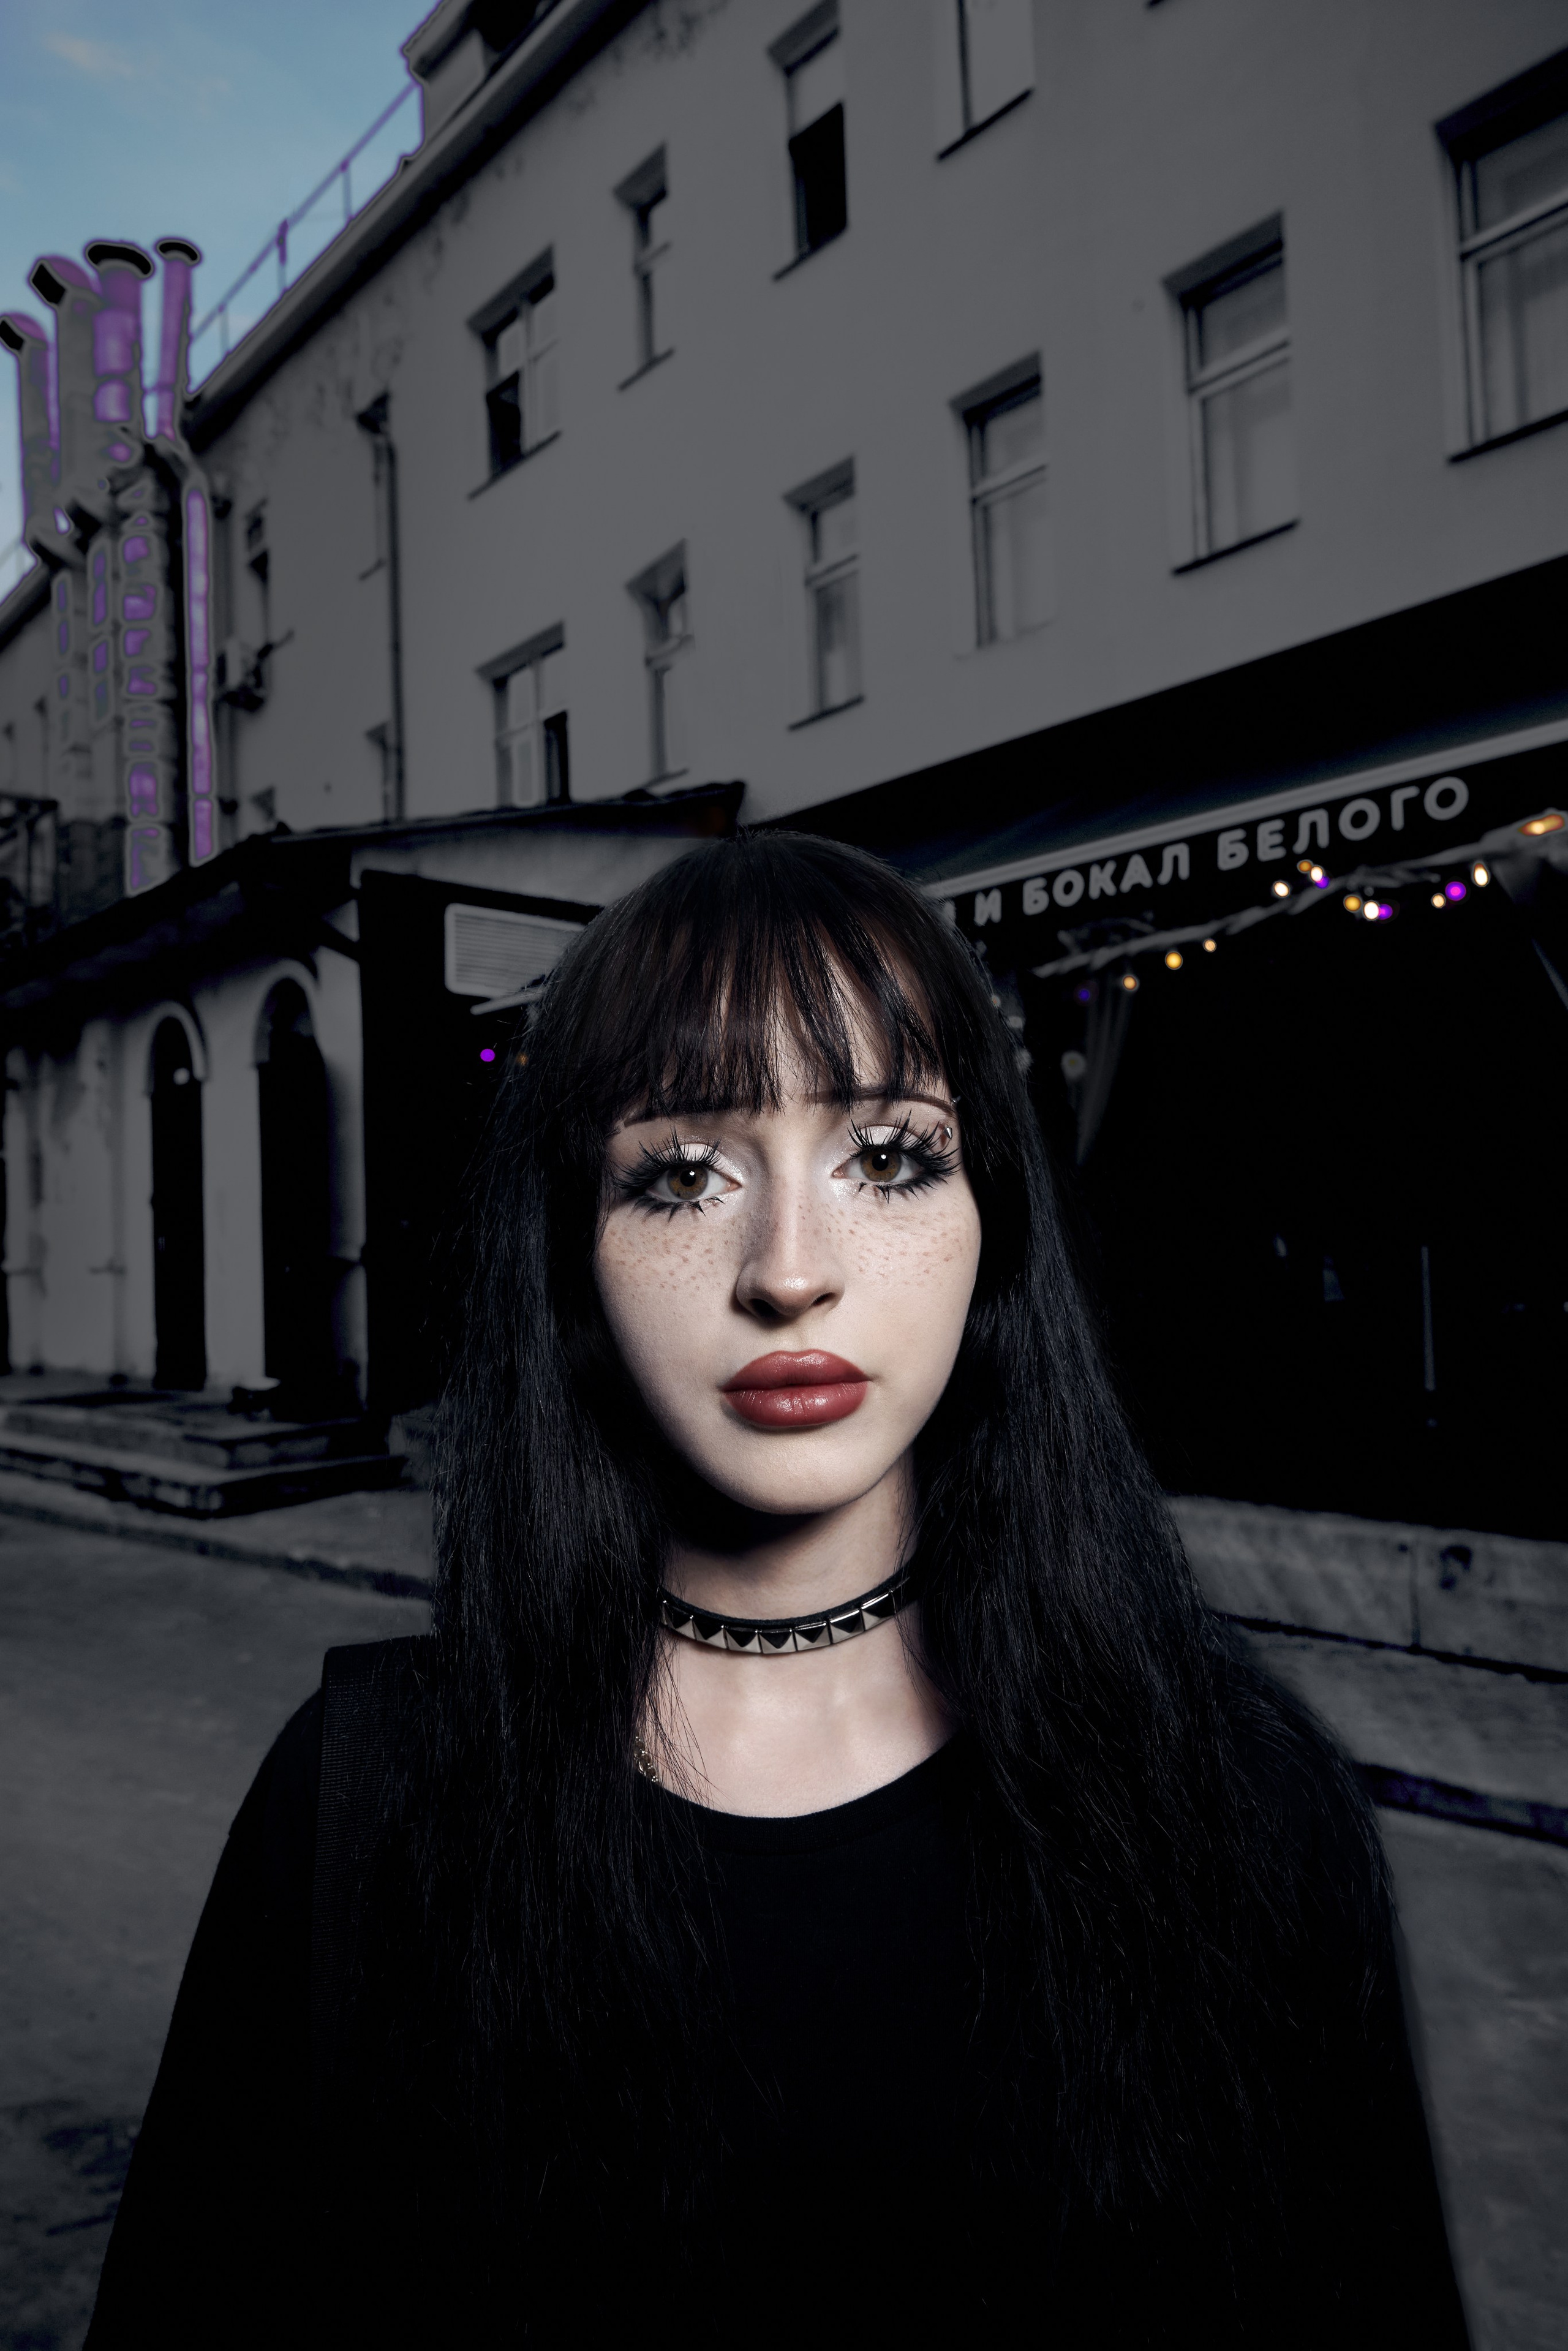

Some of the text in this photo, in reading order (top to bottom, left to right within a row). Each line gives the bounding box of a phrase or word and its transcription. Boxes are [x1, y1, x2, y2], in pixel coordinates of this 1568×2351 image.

[974, 888, 1002, 926] И
[1022, 842, 1190, 916] БОКАЛ
[1216, 775, 1469, 871] БЕЛОГО
